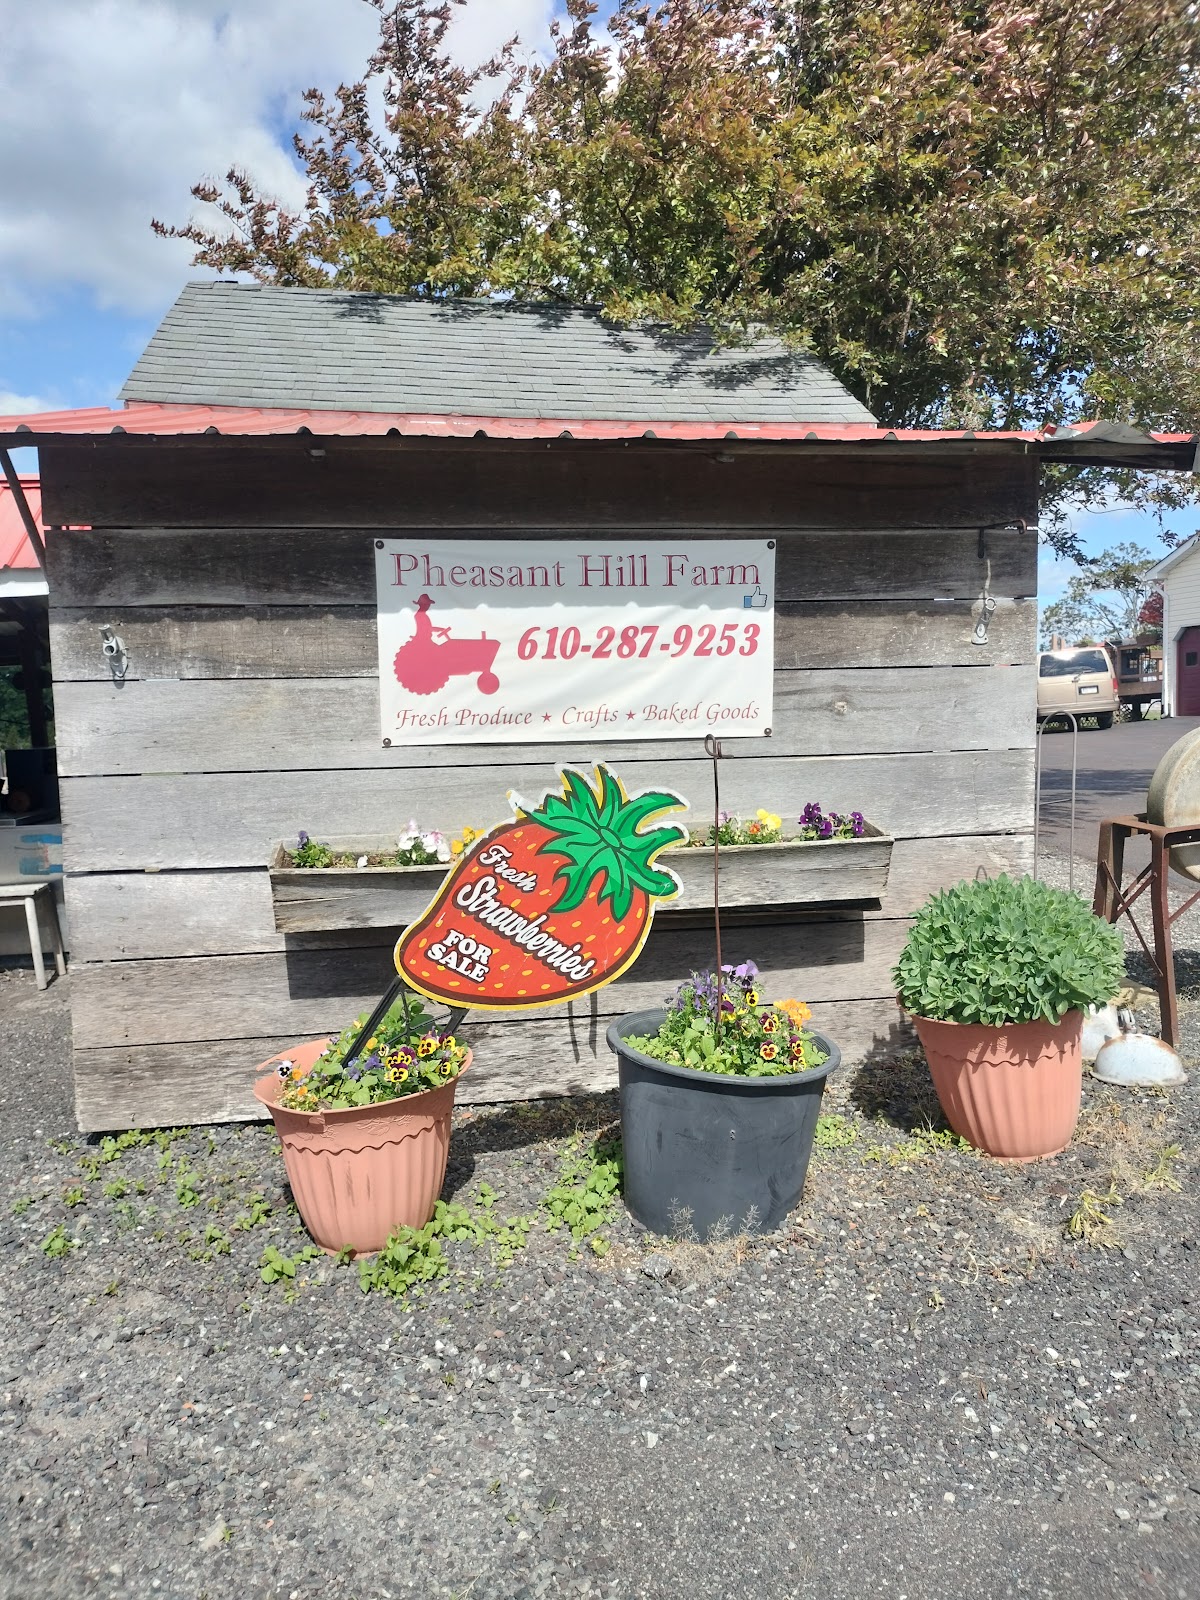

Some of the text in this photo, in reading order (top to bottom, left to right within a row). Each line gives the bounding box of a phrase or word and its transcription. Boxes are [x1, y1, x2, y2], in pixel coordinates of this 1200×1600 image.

[390, 552, 762, 588] Pheasant Hill Farm
[517, 623, 761, 661] 610-287-9253
[396, 701, 760, 730] Fresh Produce Crafts Baked Goods
[480, 845, 537, 892] Fresh
[444, 929, 491, 964] FOR
[457, 876, 595, 980] Strawberries
[427, 944, 490, 982] SALE
